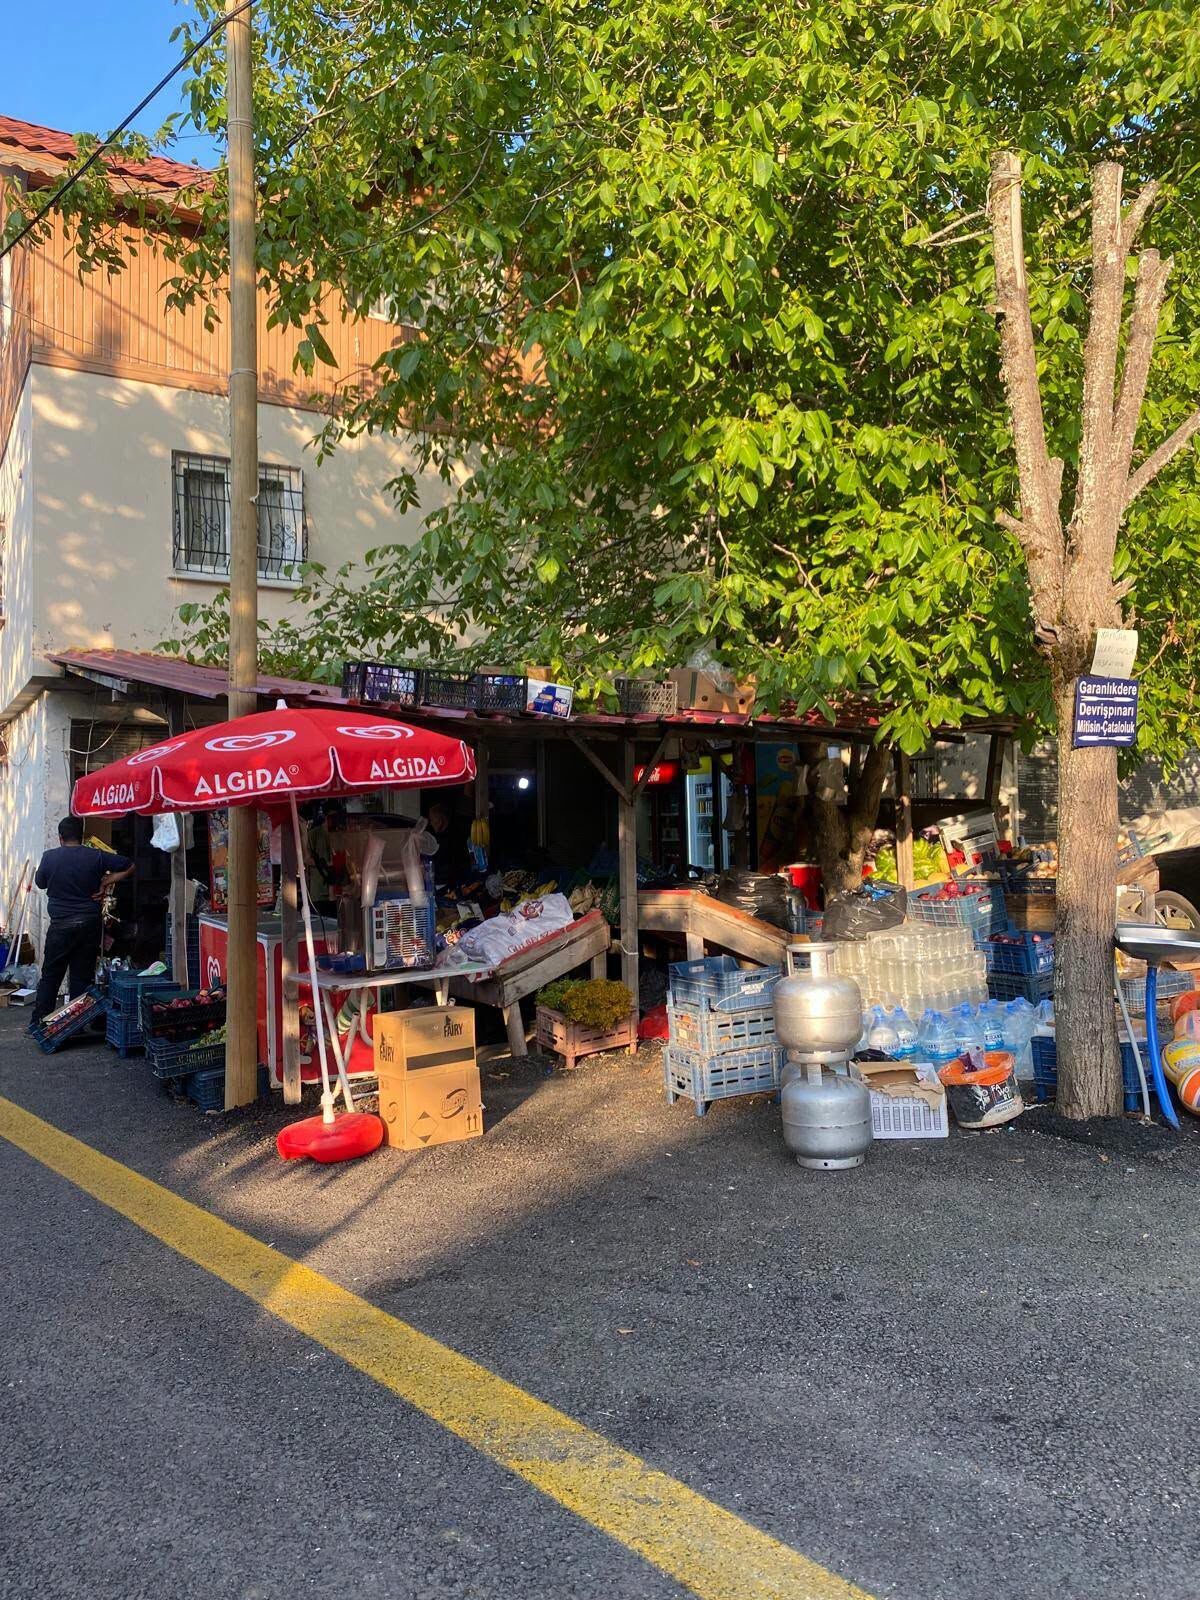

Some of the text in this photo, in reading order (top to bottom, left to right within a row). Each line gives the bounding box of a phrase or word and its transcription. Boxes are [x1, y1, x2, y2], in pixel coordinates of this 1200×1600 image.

[1080, 681, 1137, 695] Garanlıkdere
[1080, 703, 1134, 719] Devrişpınarı
[444, 1023, 463, 1038] FAIRY
[379, 1044, 394, 1062] FAIRY
